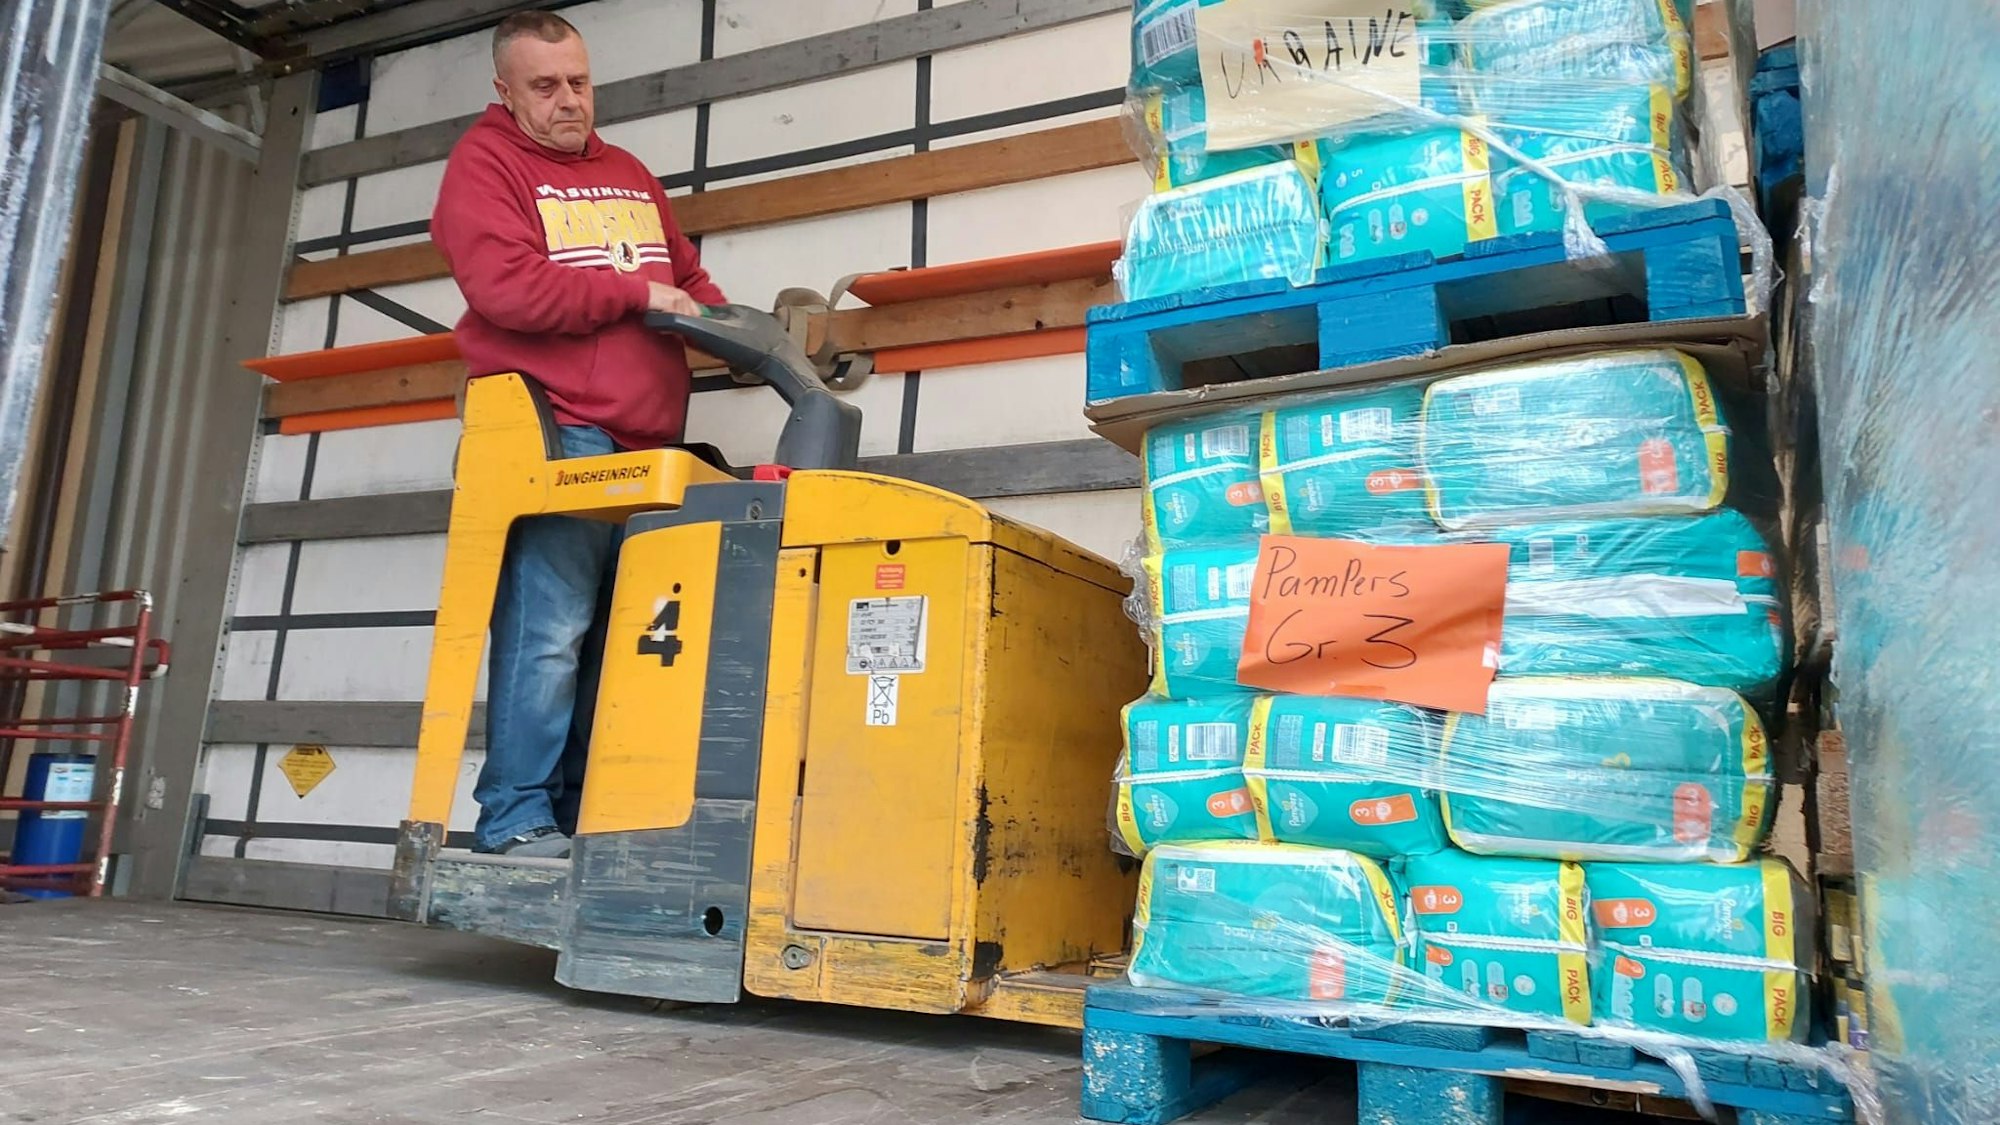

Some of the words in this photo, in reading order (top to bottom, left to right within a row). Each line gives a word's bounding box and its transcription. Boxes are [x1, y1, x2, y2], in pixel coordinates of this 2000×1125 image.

[1221, 8, 1413, 99] UKRAINE
[1467, 136, 1481, 157] BIG
[1659, 158, 1674, 192] PACK
[536, 184, 652, 200] WASHINGTON
[1470, 189, 1485, 224] PACK
[1694, 381, 1713, 415] PACK
[1262, 432, 1271, 458] PACK
[555, 464, 651, 486] JUNGHEINRICH
[1716, 452, 1726, 474] BIG
[1230, 488, 1243, 499] 3
[1306, 478, 1318, 511] Pampers
[1370, 478, 1384, 487] 3
[1172, 492, 1184, 524] Pampers
[1271, 492, 1283, 511] BIG
[638, 600, 682, 667] 4
[1361, 614, 1417, 670] 3
[1182, 632, 1194, 666] Pampers
[872, 709, 890, 725] Pb
[1250, 723, 1262, 755] PACK
[1749, 724, 1761, 759] PACK
[1122, 803, 1131, 822] BIG
[1151, 794, 1164, 827] Pampers
[1212, 800, 1225, 809] 3
[1289, 792, 1301, 827] Pampers
[1355, 807, 1370, 817] 3
[1747, 804, 1759, 827] BIG
[1443, 895, 1457, 904] 3
[1566, 897, 1577, 920] BIG
[1634, 908, 1650, 918] 3
[1722, 898, 1737, 940] Pampers
[1772, 911, 1786, 937] BIG
[1567, 969, 1580, 1004] PACK
[1773, 988, 1787, 1026] PACK
